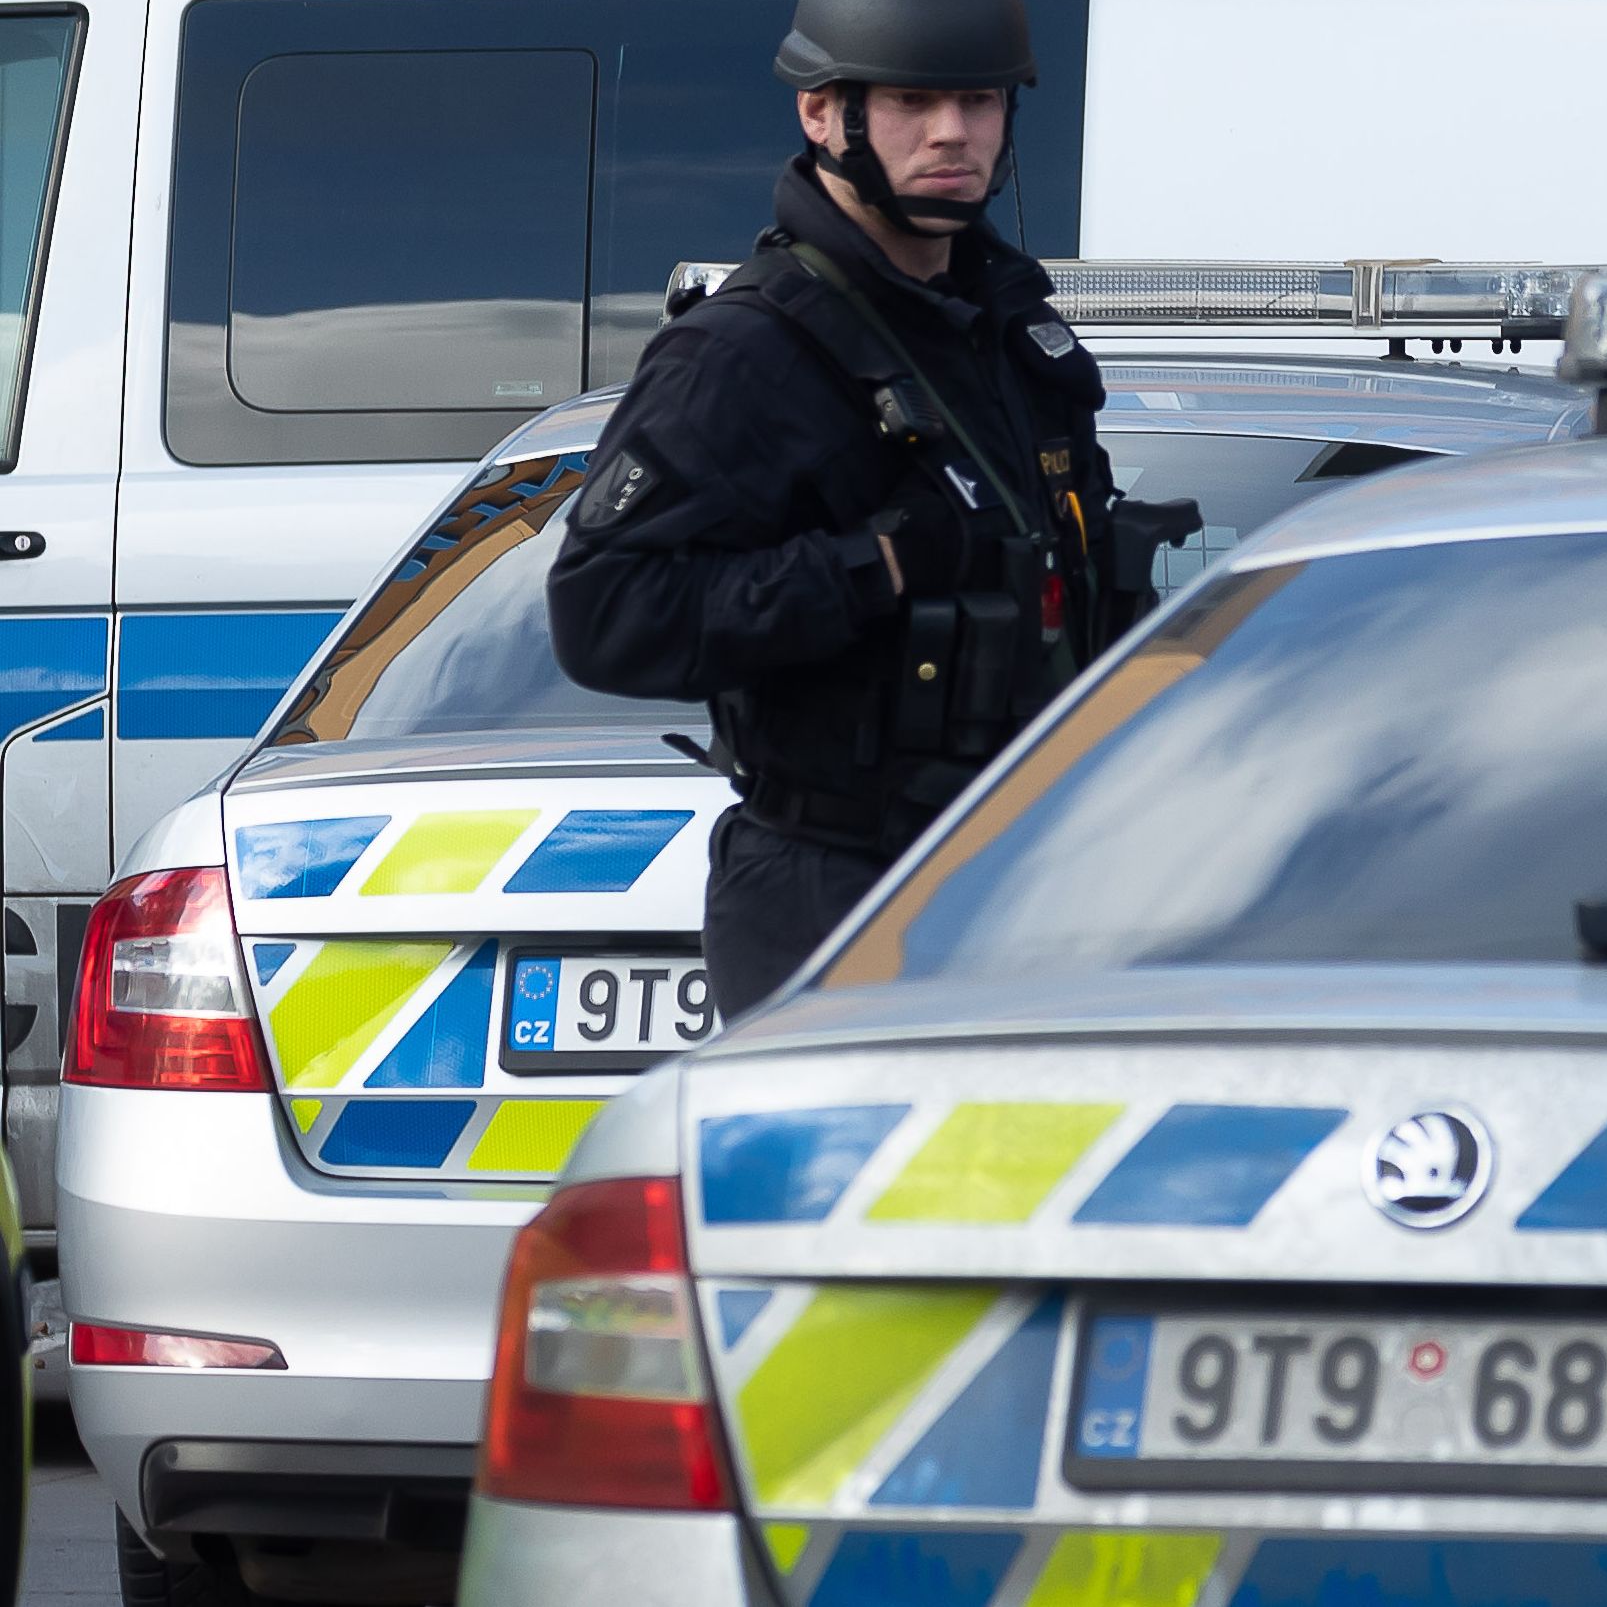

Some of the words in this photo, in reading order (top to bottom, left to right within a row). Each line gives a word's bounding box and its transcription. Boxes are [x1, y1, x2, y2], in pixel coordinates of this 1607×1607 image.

[513, 1020, 550, 1044] CZ
[576, 968, 716, 1042] 9T9
[1172, 1333, 1381, 1445] 9T9
[1080, 1407, 1137, 1450] CZ
